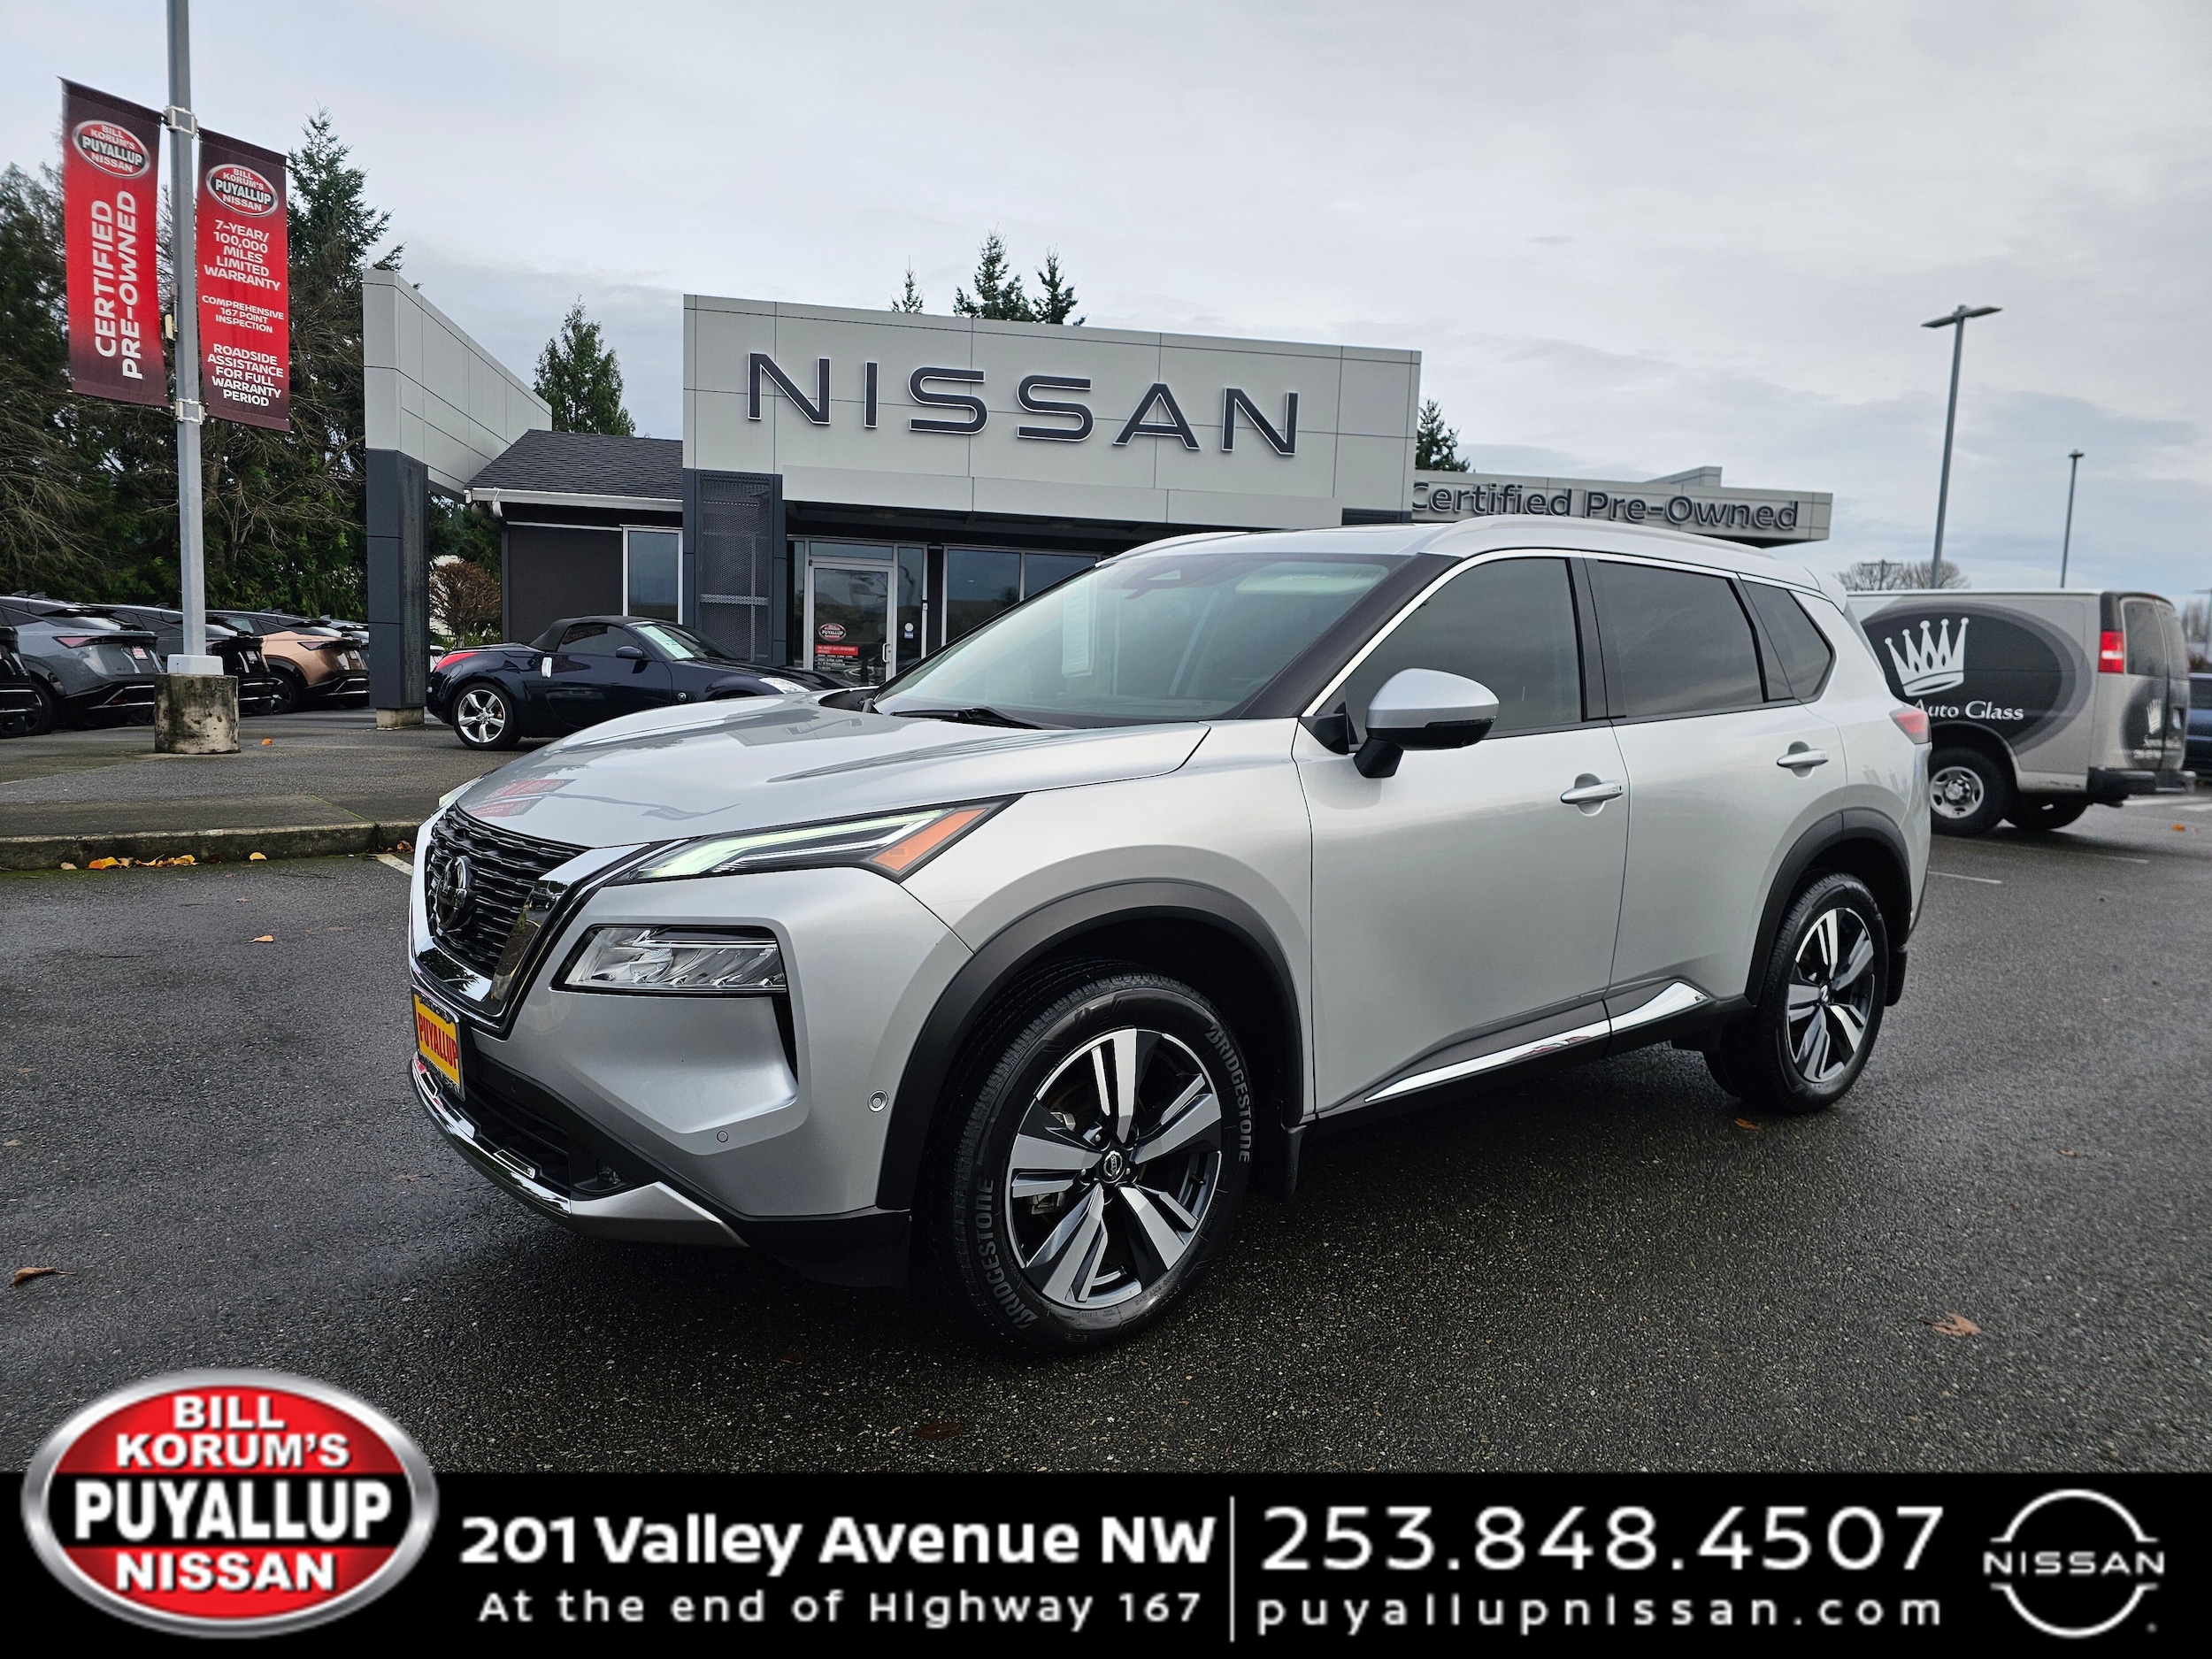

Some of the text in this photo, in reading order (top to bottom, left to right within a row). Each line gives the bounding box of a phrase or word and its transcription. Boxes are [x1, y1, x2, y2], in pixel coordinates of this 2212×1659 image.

[90, 129, 135, 150] KORUM'S
[102, 125, 124, 139] BILL
[82, 135, 142, 165] PUYALLUP
[91, 153, 133, 173] NISSAN
[233, 168, 253, 180] BILL
[215, 179, 272, 204] PUYALLUP
[222, 172, 265, 190] KORUM'S
[222, 194, 262, 211] NISSAN
[215, 219, 269, 243] 7-YEAR/
[213, 231, 268, 254] 100,000
[216, 255, 270, 277] LIMITED
[223, 245, 264, 265] MILES
[91, 200, 117, 357] CERTIFIED
[117, 190, 143, 380] PRE-OWNED
[204, 264, 280, 291] WARRANTY
[202, 295, 284, 320] COMPREHENSIVE
[220, 307, 268, 325] 167 POINT
[215, 314, 273, 334] INSPECTION
[213, 343, 278, 365] ROADSIDE
[207, 353, 284, 378] ASSISTANCE
[215, 365, 275, 387] FOR FULL
[211, 376, 281, 398] WARRANTY
[223, 389, 270, 407] PERIOD
[748, 352, 1300, 456] NISSAN
[1412, 481, 1800, 531] Certified Pre-Owned
[1964, 700, 2024, 721] Glass
[417, 1011, 458, 1070] PUYALLUP
[1204, 1024, 1252, 1163] BRIDGESTONE
[975, 1179, 1039, 1328] BRIDGESTONE
